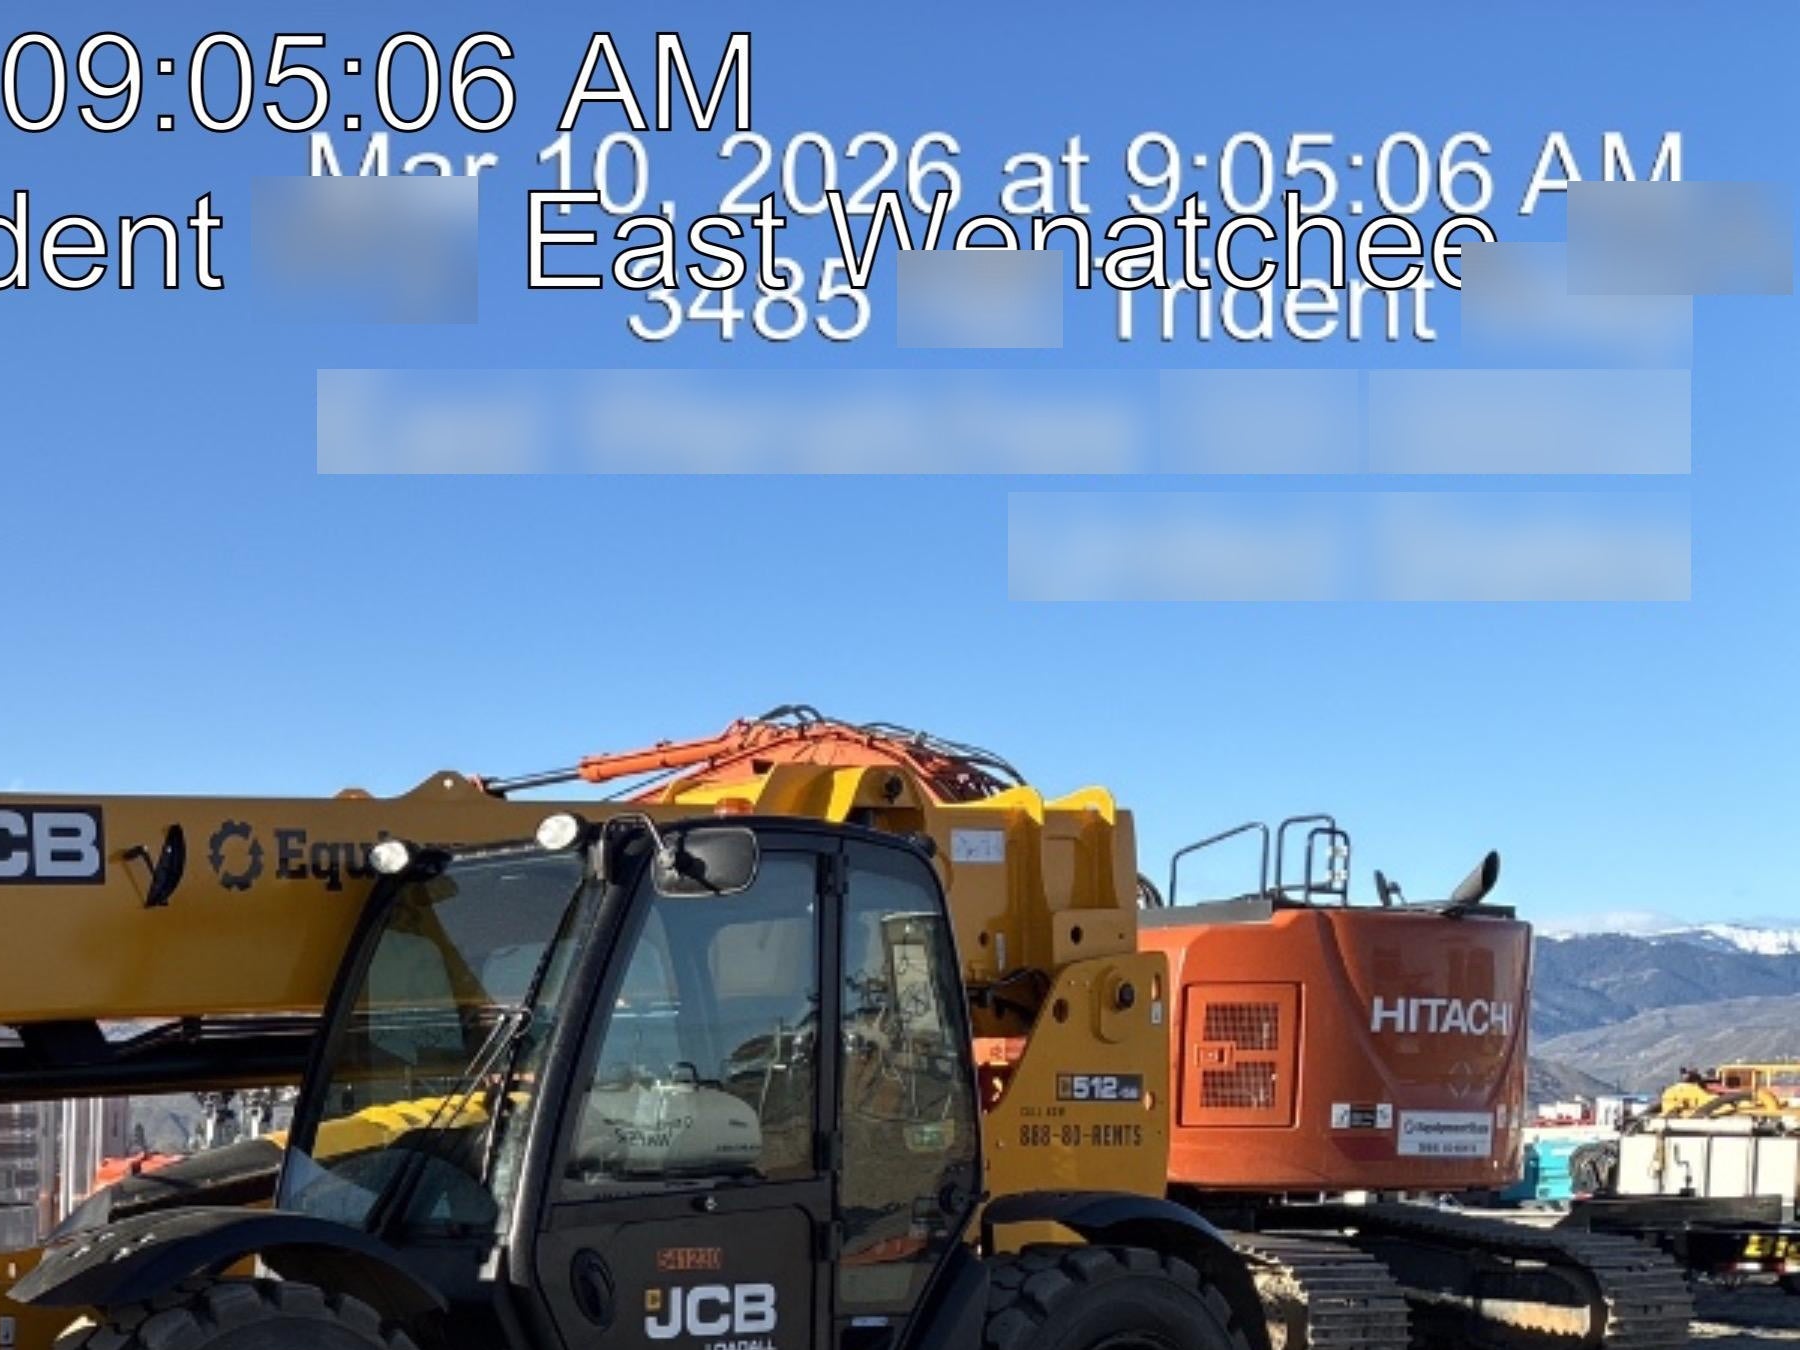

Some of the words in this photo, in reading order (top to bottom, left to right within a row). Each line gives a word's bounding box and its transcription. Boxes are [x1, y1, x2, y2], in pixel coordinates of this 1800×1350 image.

[274, 828, 389, 892] Equ
[1370, 995, 1513, 1036] HITACHI
[643, 1283, 778, 1340] JCB
